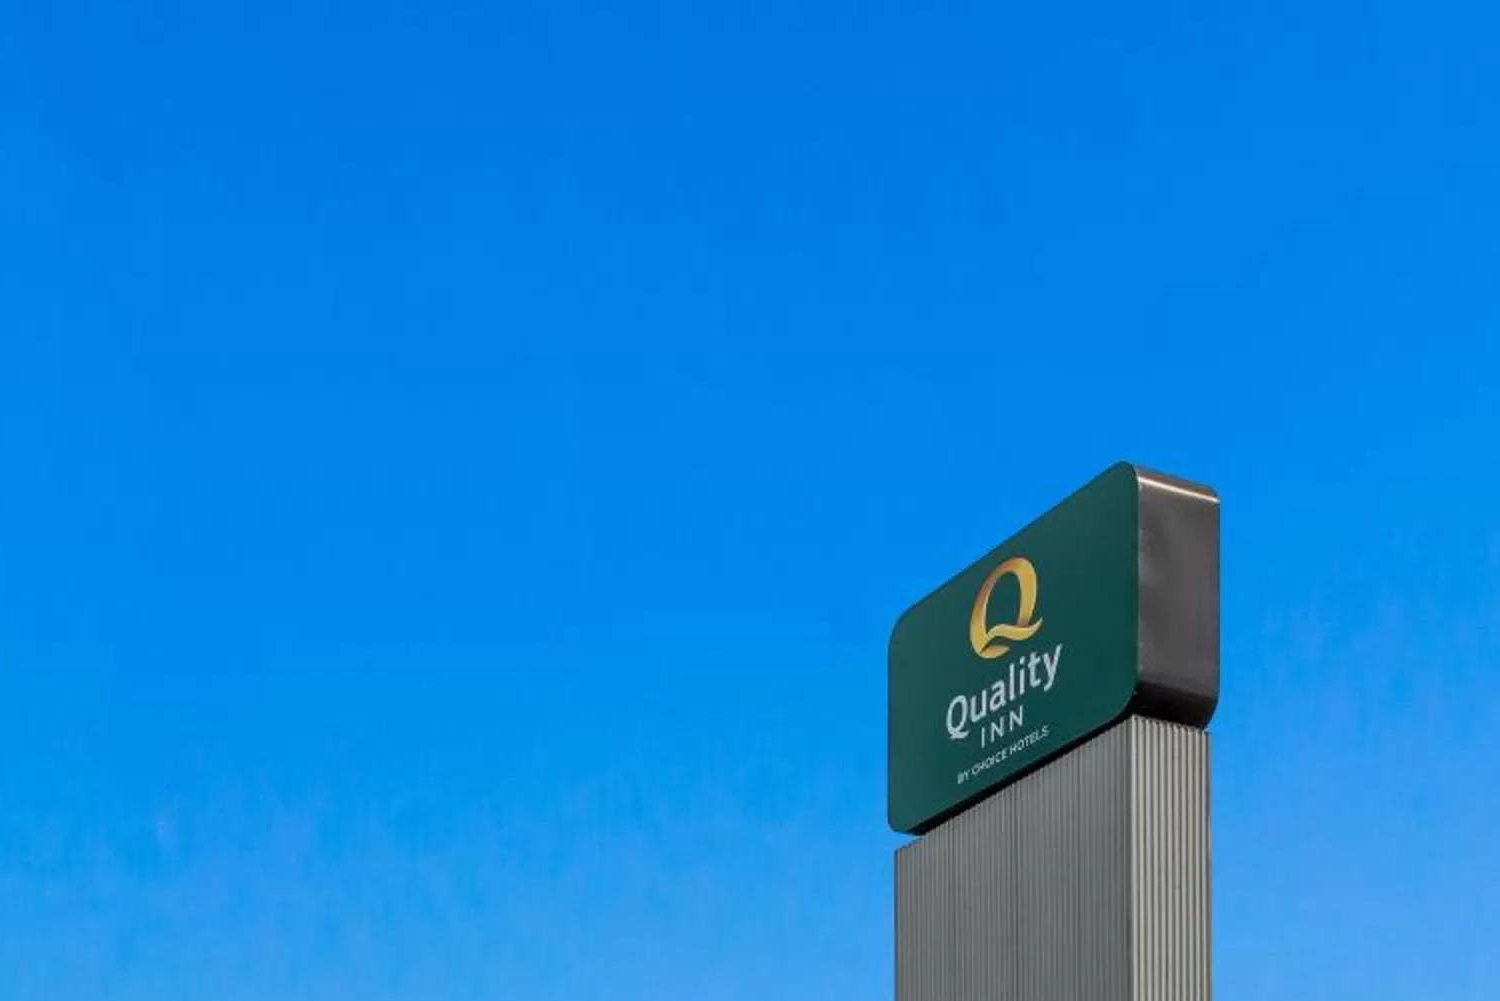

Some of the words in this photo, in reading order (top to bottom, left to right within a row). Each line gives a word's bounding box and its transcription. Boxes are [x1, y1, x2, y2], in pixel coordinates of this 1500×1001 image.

[969, 557, 1043, 659] Q
[946, 643, 1063, 740] Quality
[980, 706, 1024, 748] INN
[957, 767, 970, 784] BY
[971, 748, 1009, 776] CHOICE
[1009, 726, 1049, 758] HOTELS
